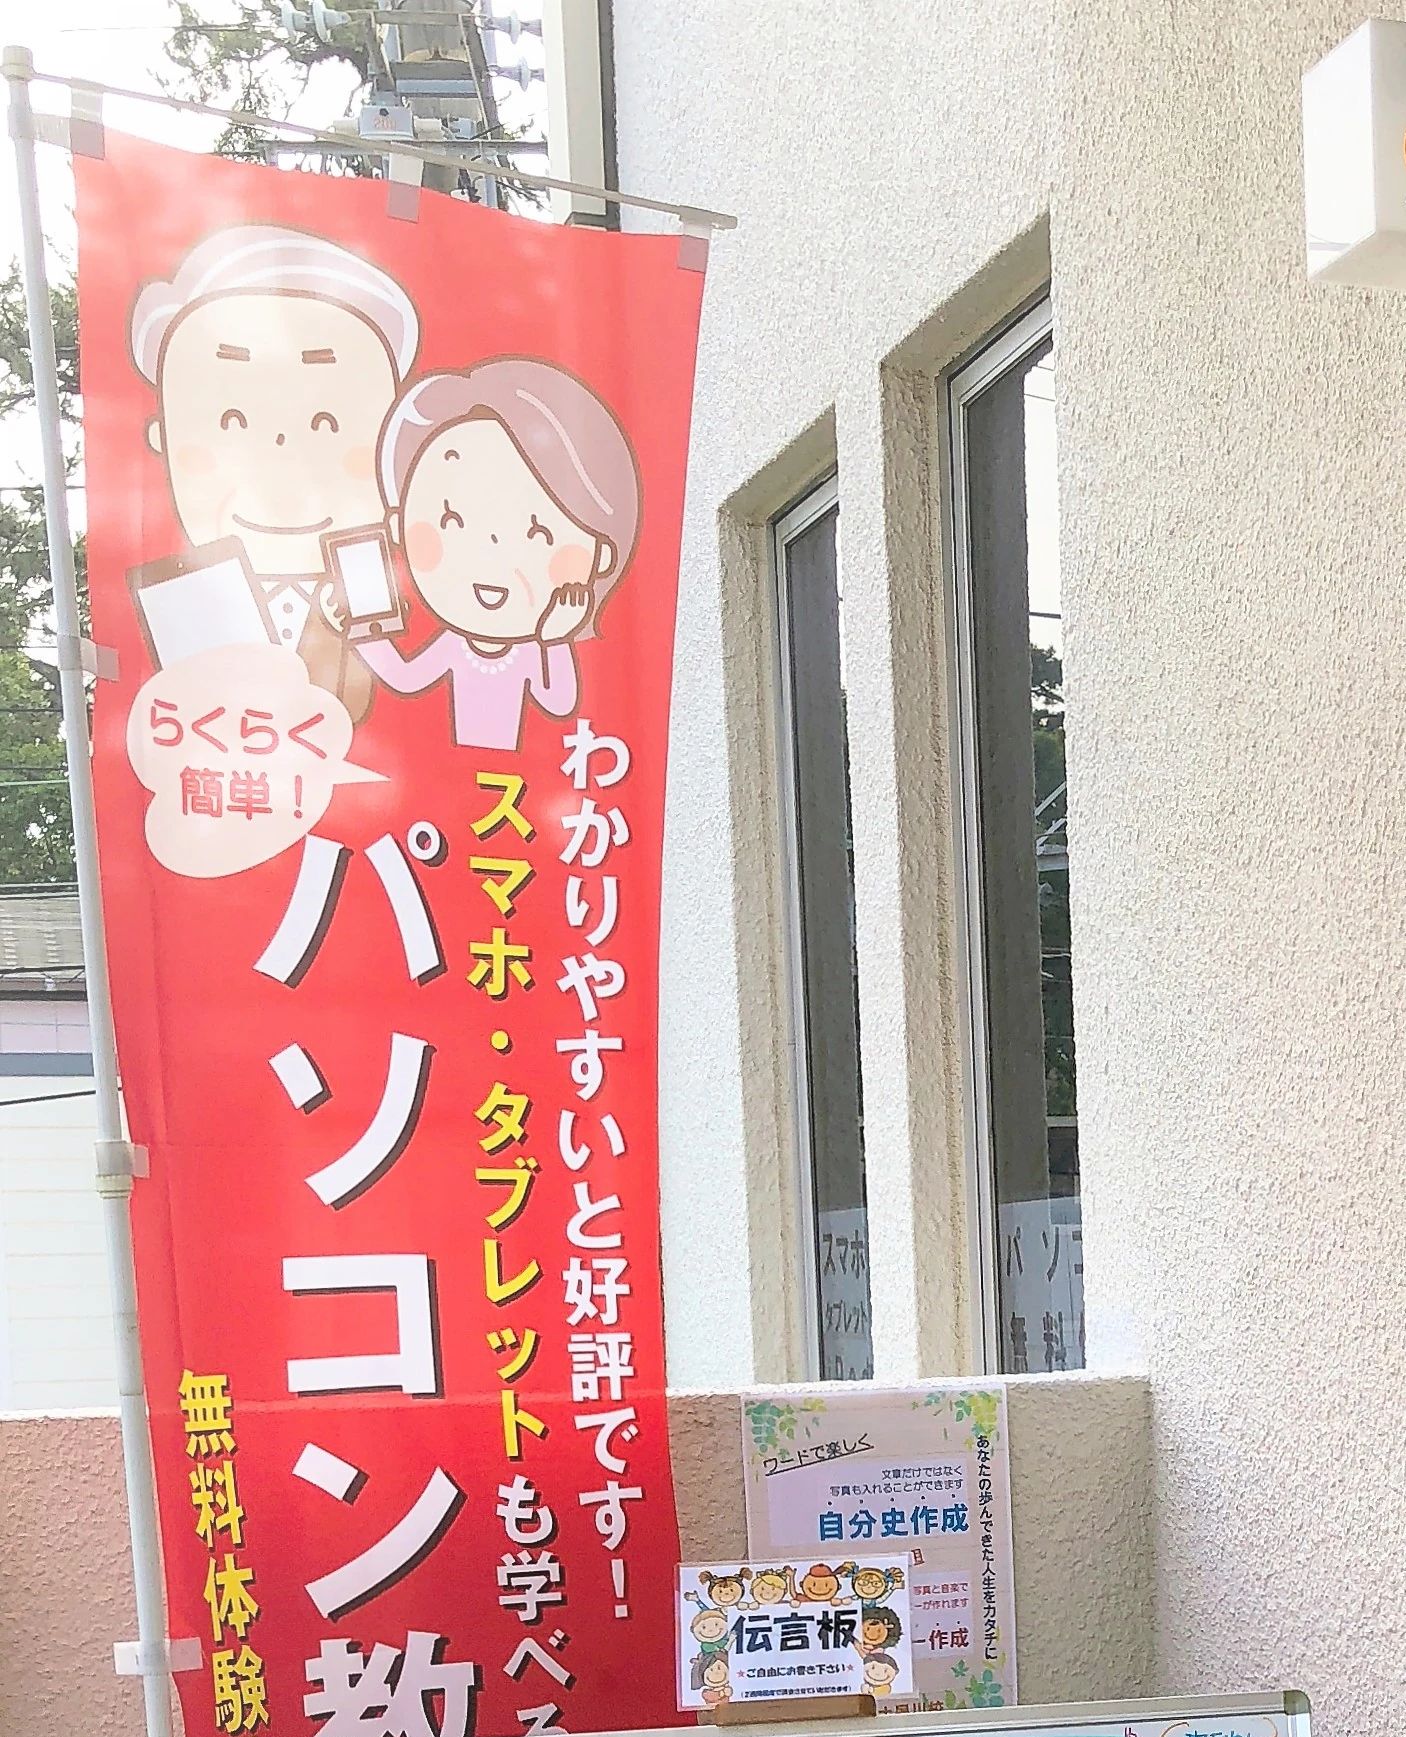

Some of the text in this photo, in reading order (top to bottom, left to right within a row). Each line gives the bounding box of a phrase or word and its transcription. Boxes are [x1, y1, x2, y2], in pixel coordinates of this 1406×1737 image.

[149, 698, 327, 755] らくらく
[179, 766, 305, 822] 簡単!
[554, 717, 643, 1619] わかりやすいと好評です!
[763, 1433, 875, 1472] ワードで楽しく
[881, 1464, 963, 1481] 文章だけではなく
[829, 1478, 964, 1497] 写真も入れることができます
[819, 1502, 970, 1542] 自分史作成
[975, 1434, 999, 1661] あなたの歩んできた人生をカタチに
[734, 1608, 859, 1655] 伝言板
